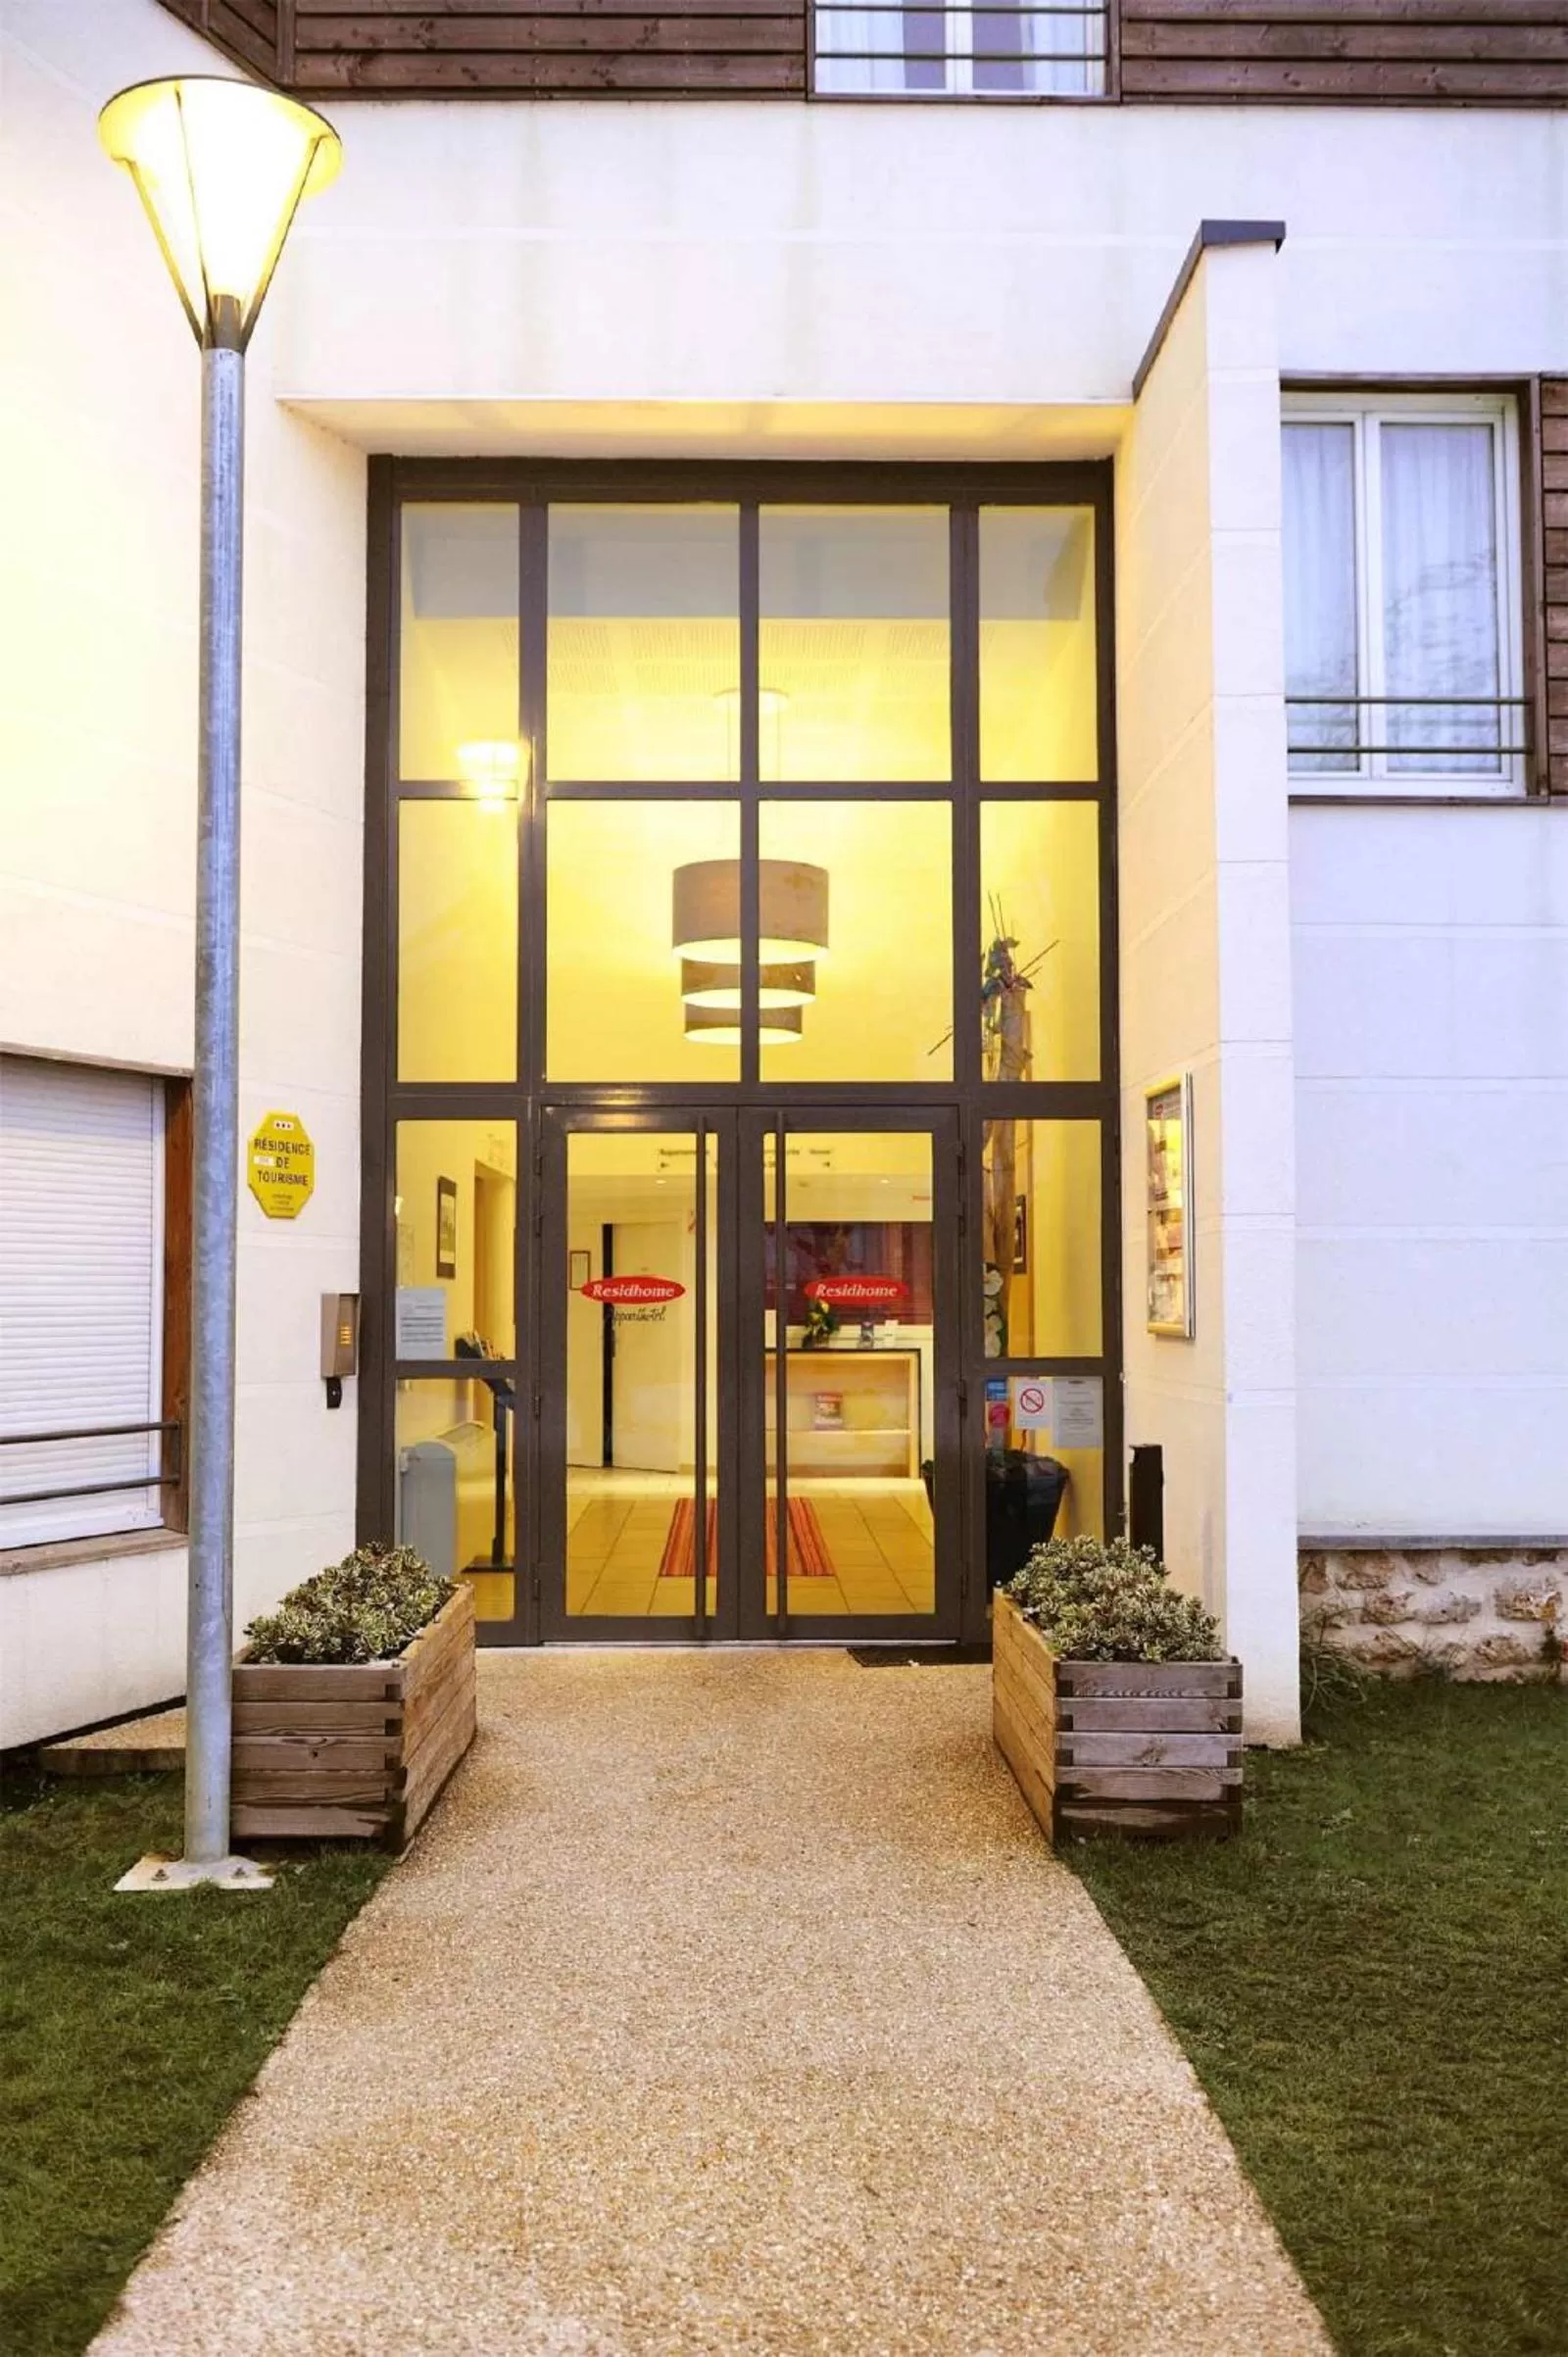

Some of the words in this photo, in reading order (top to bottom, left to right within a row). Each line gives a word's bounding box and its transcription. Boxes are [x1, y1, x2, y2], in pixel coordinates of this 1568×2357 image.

[275, 1156, 290, 1169] DE
[257, 1169, 310, 1187] TOURISME
[591, 1283, 675, 1298] Residhome
[814, 1282, 899, 1297] Residhome
